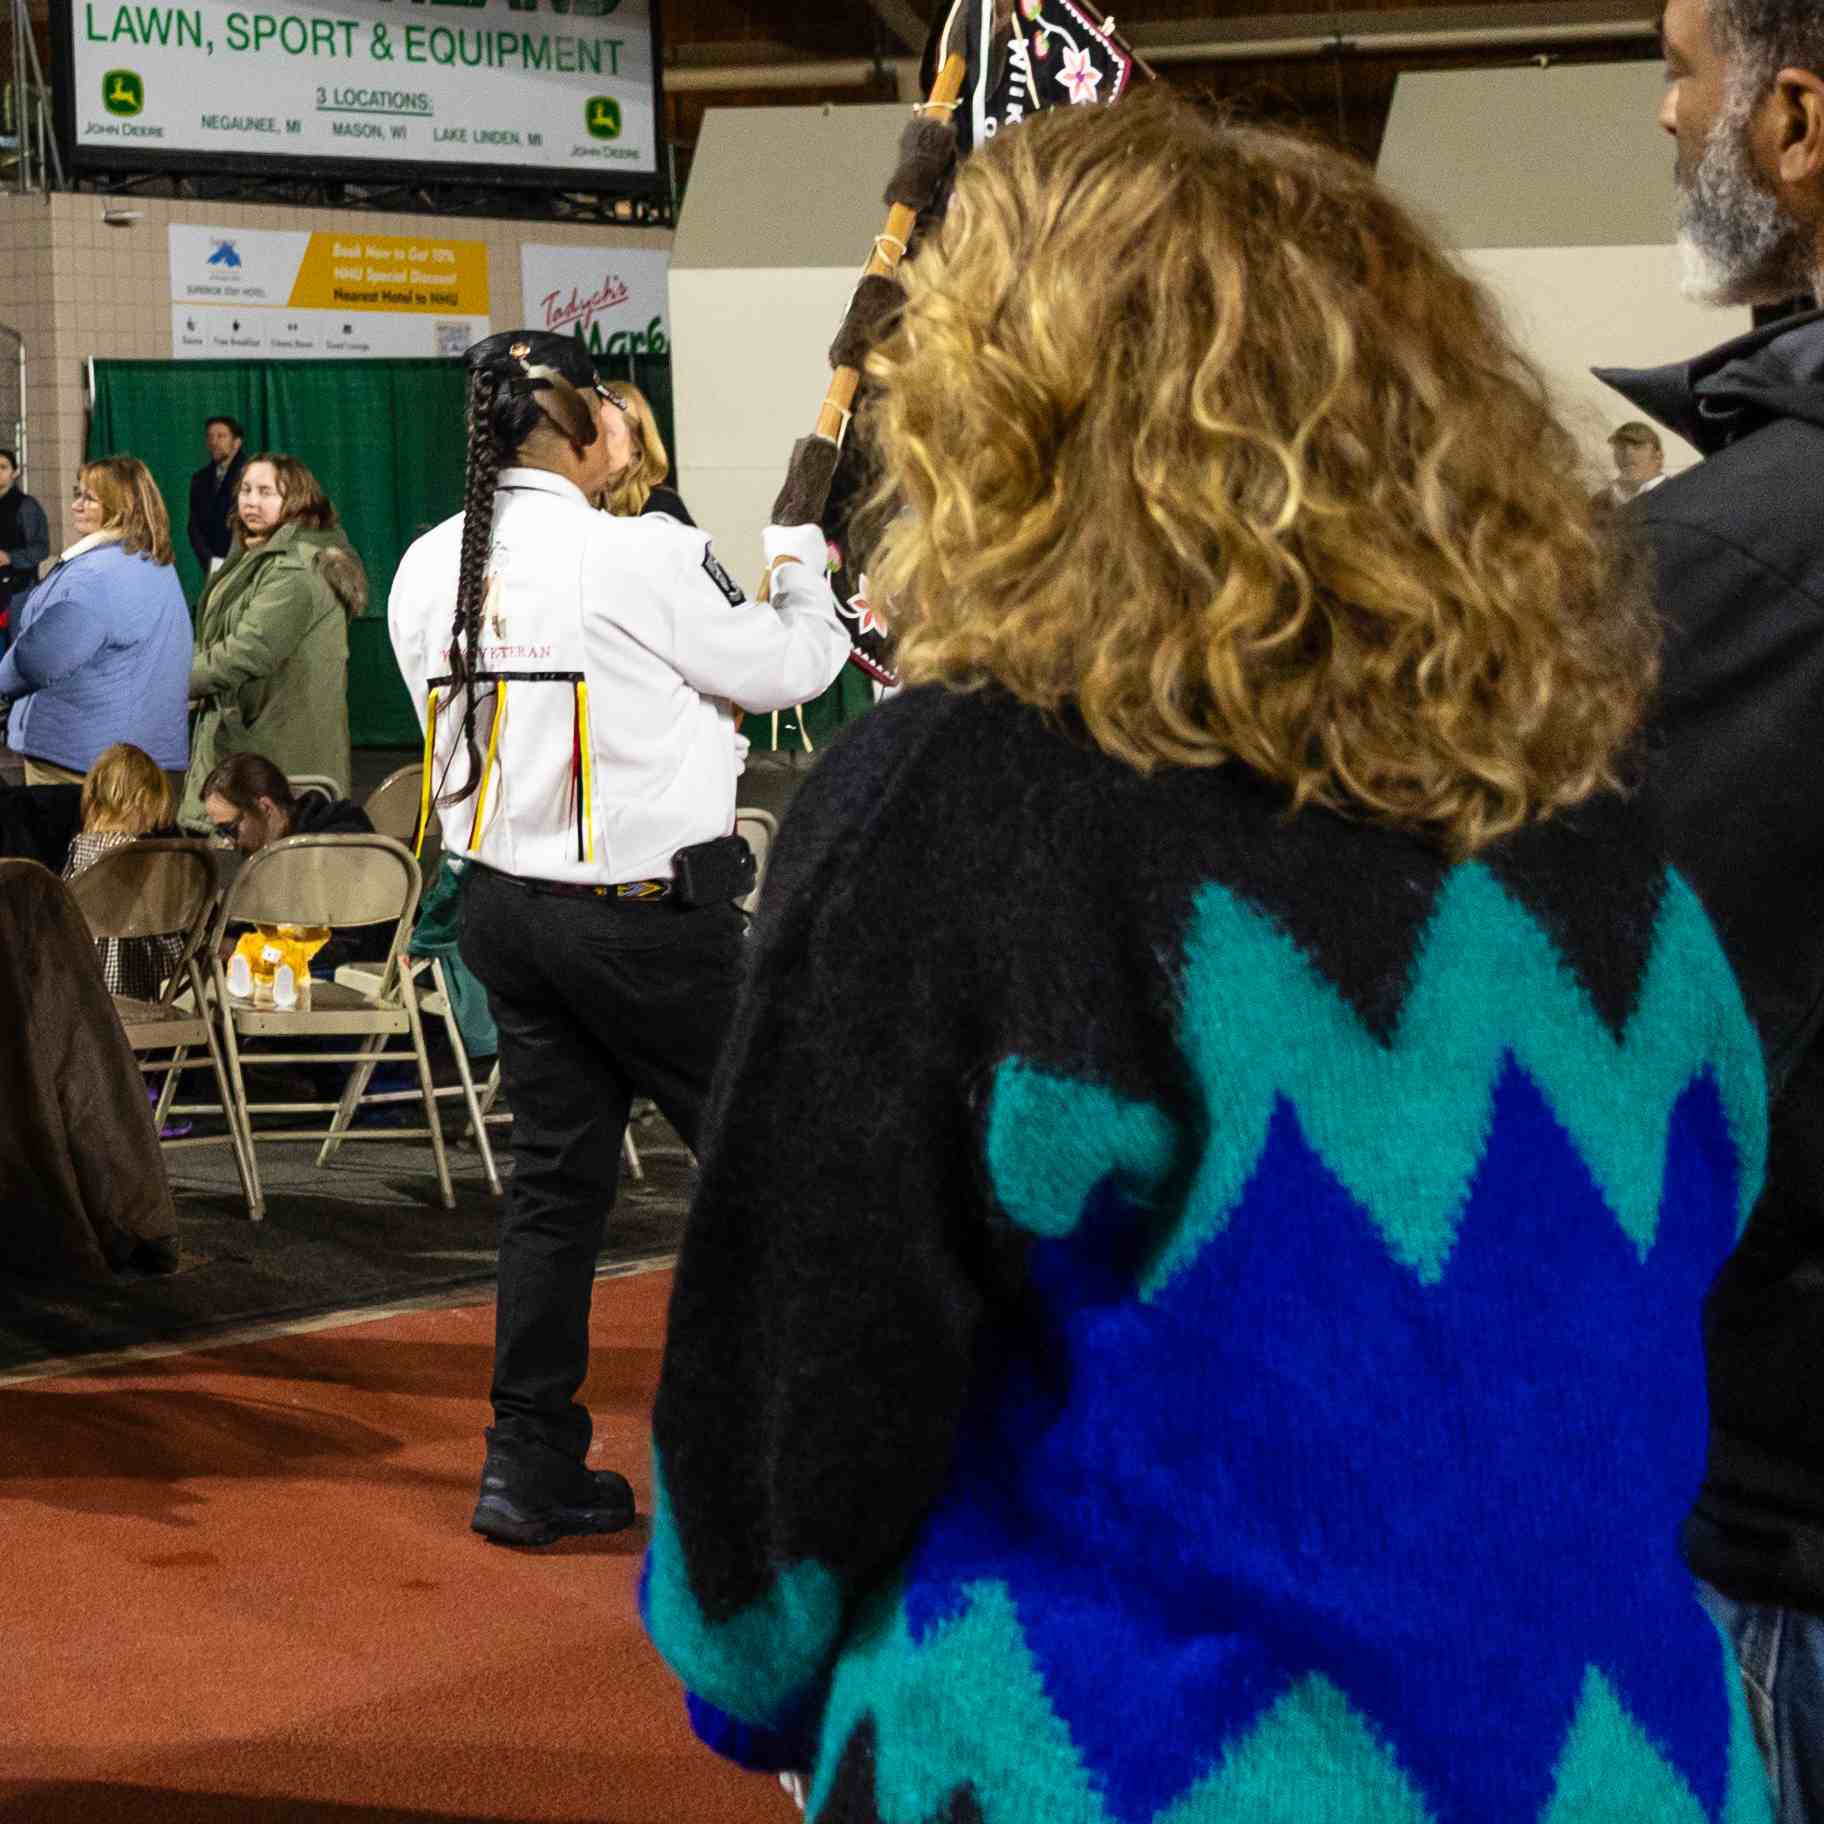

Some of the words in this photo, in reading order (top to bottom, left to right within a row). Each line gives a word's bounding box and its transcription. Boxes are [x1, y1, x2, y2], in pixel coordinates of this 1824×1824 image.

[85, 2, 215, 57] LAWN,
[225, 10, 361, 59] SPORT
[369, 22, 394, 62] &
[405, 24, 626, 77] EQUIPMENT
[316, 86, 328, 106] 3
[333, 87, 434, 112] LOCATIONS:
[285, 119, 302, 135] MI
[390, 125, 407, 140] WI
[433, 127, 468, 144] LAKE
[527, 132, 543, 147] MI
[574, 313, 671, 355] Mark
